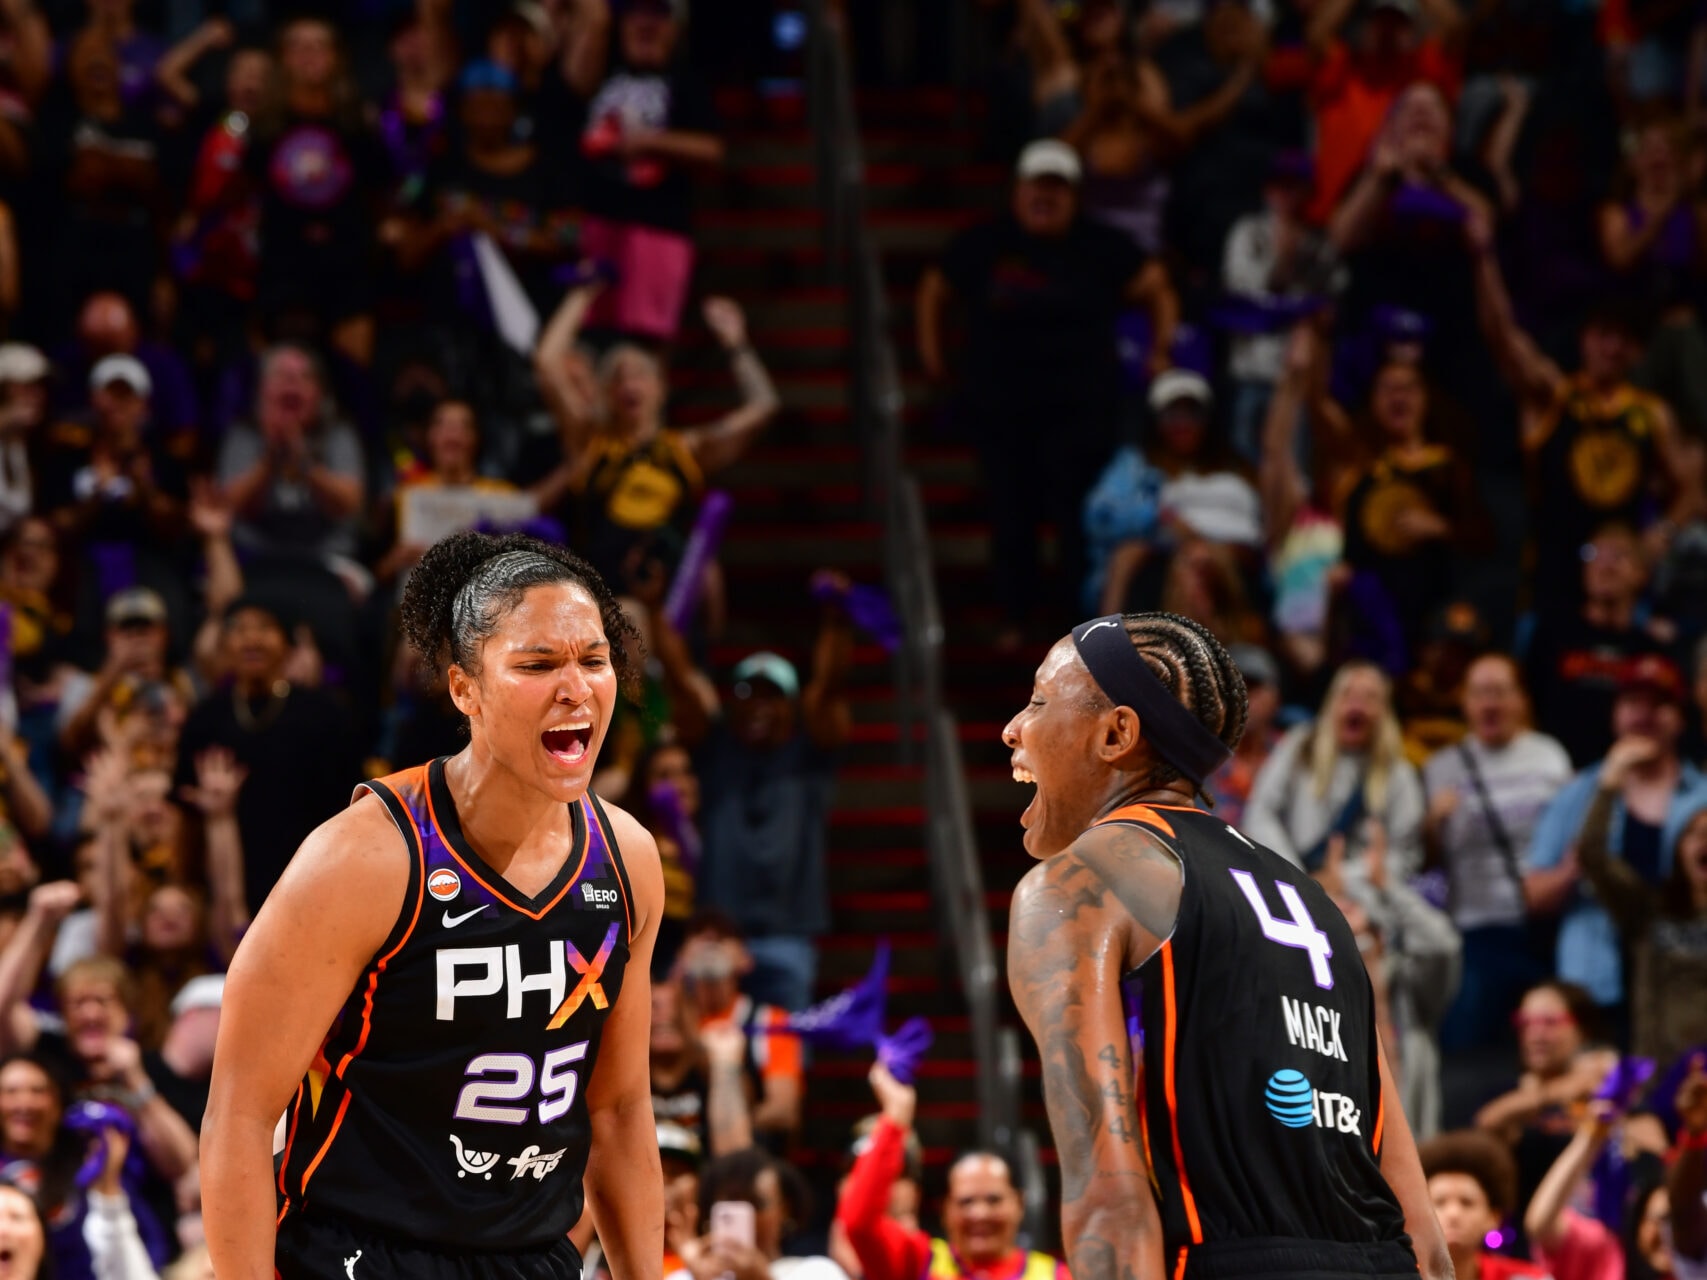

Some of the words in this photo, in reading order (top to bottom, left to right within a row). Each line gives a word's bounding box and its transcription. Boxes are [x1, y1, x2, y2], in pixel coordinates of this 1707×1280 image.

[581, 881, 618, 902] HERO
[1228, 867, 1335, 990] 4
[436, 921, 620, 1030] PHX
[1281, 995, 1349, 1062] MACK
[453, 1040, 590, 1126] 25
